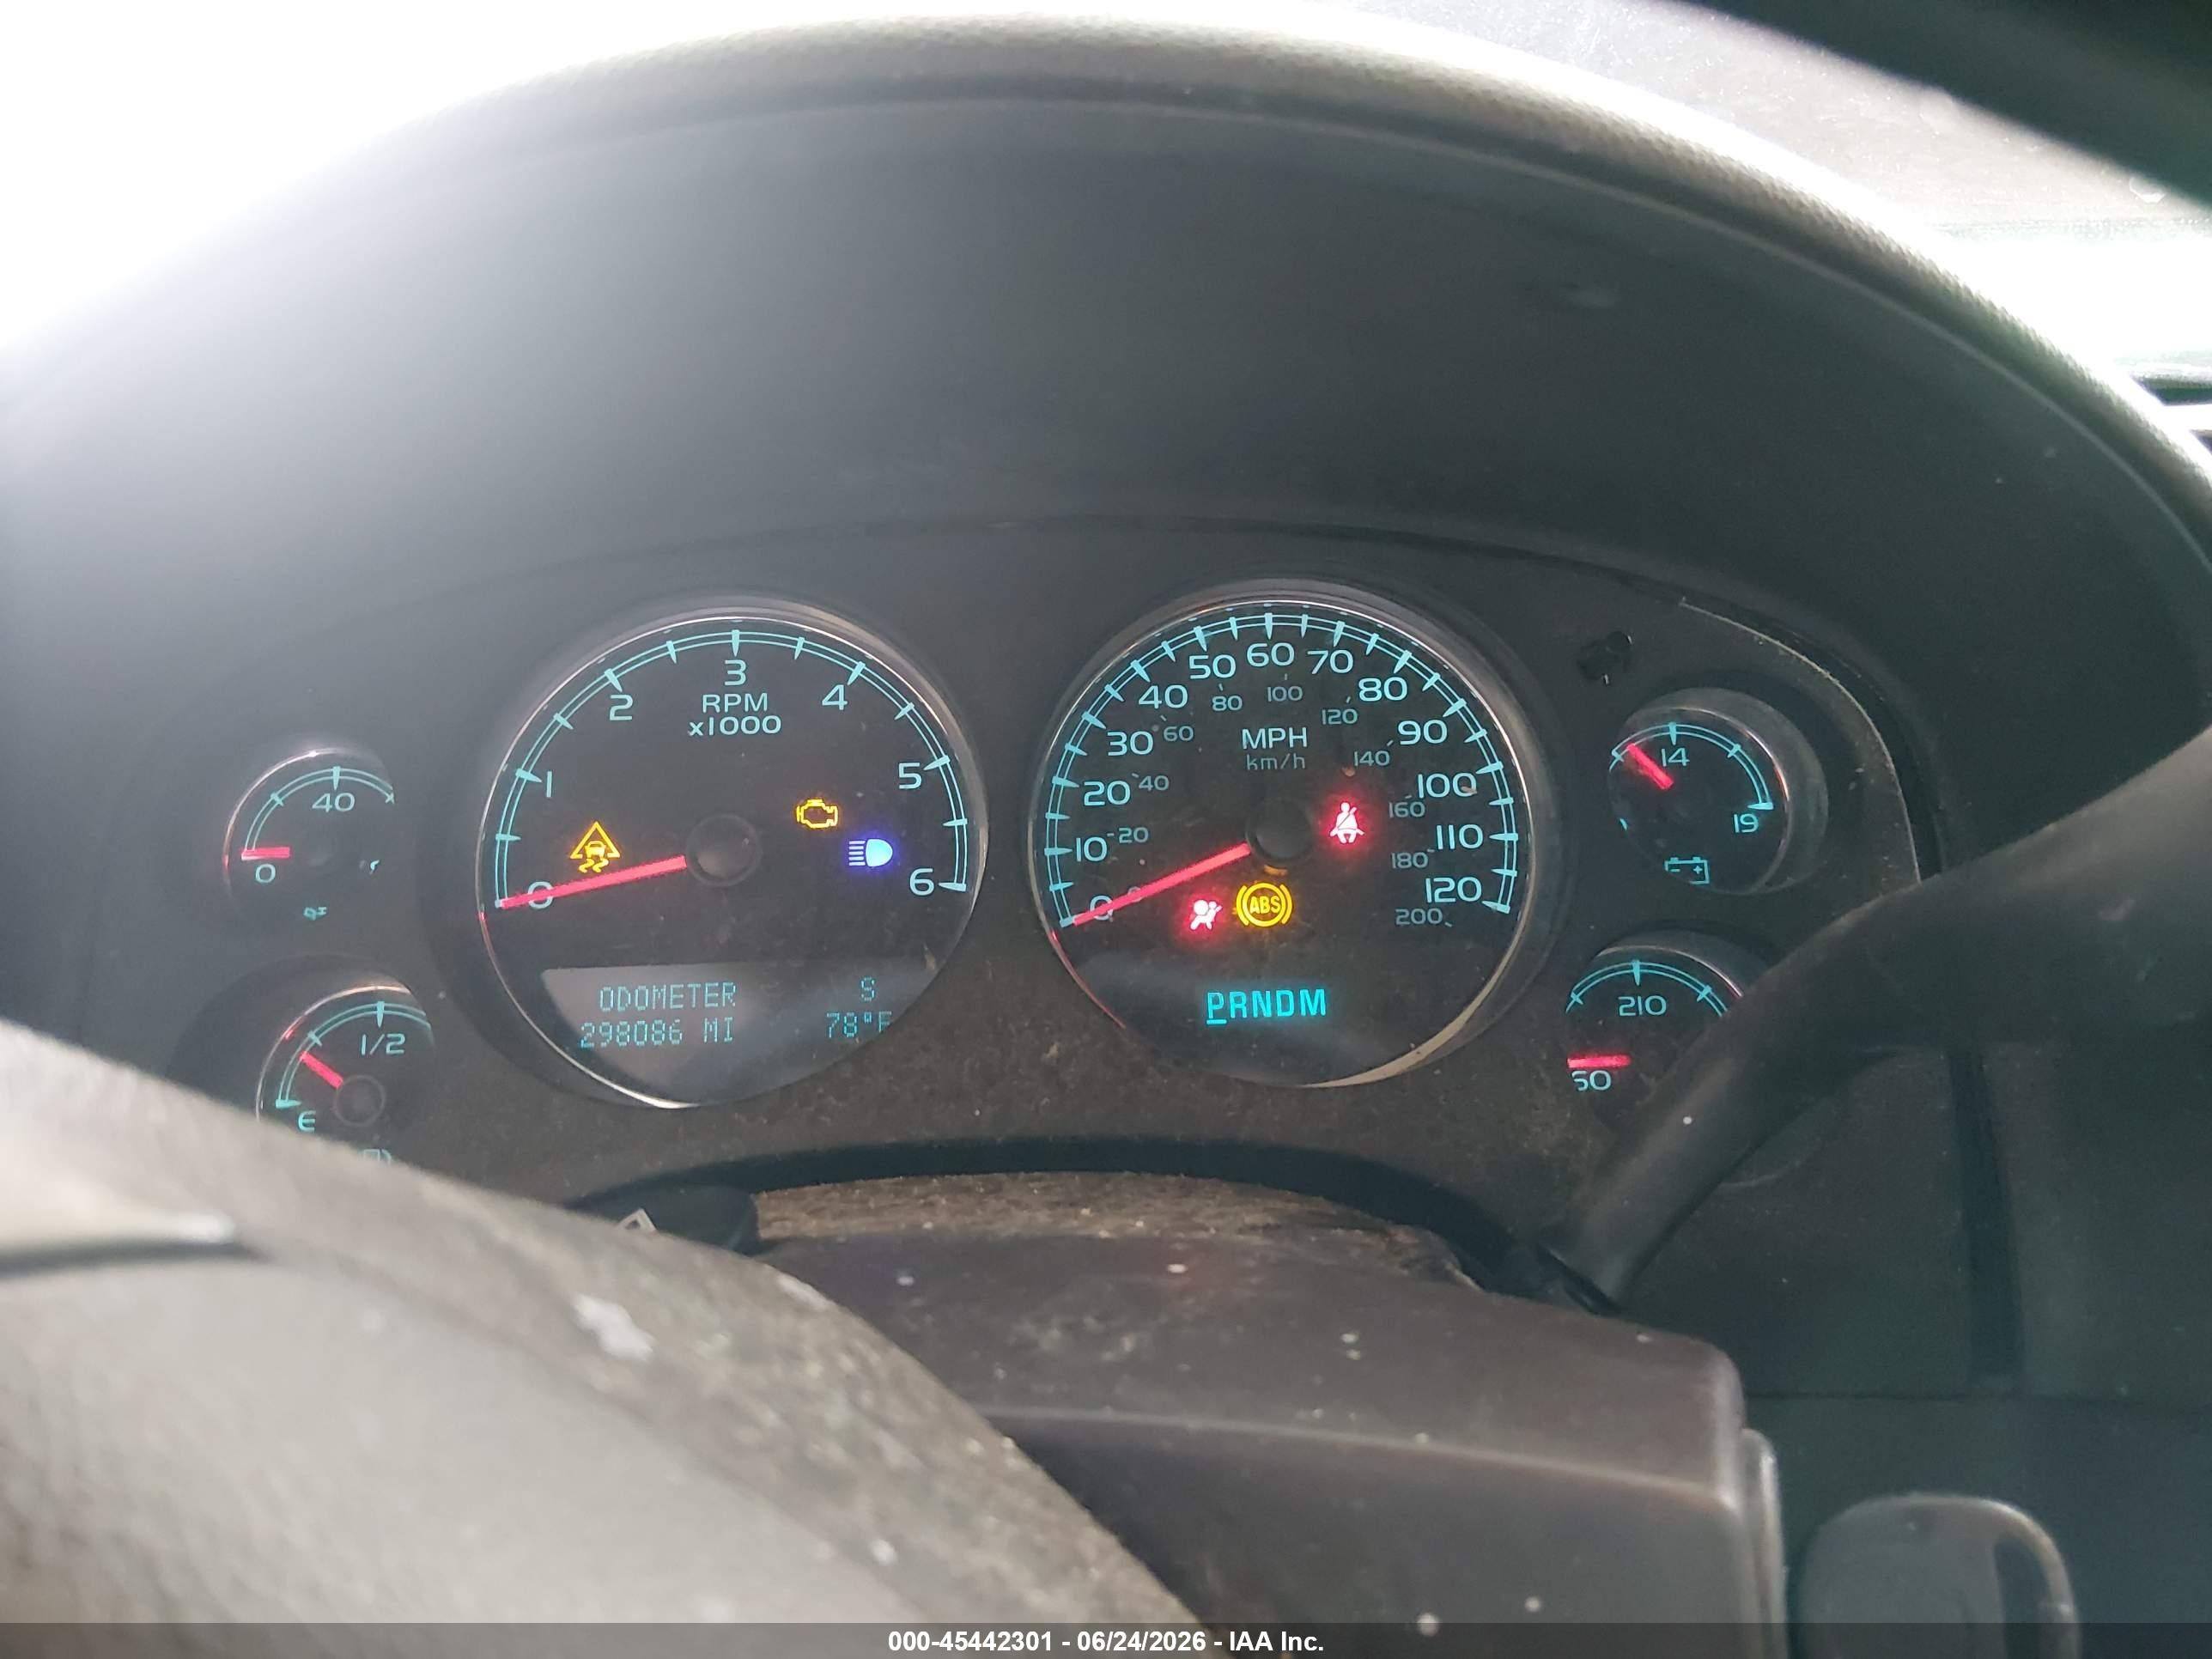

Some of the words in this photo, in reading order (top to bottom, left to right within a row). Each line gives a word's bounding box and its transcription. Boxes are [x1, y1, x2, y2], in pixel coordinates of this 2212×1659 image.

[1188, 654, 1237, 679] 50
[1247, 643, 1294, 667] 60
[1308, 649, 1354, 674] 70
[724, 659, 747, 685] 3
[822, 684, 848, 710] 4
[1138, 684, 1188, 709] 40
[1267, 685, 1303, 702] 100
[1358, 677, 1407, 702] 80
[610, 695, 634, 721] 2
[702, 693, 768, 713] RPM
[1212, 695, 1243, 712] 80
[689, 714, 781, 737] x1000
[1322, 708, 1358, 725] 120
[1107, 731, 1153, 757] 30
[1163, 726, 1194, 742] 60
[1242, 727, 1308, 748] MPH
[1397, 720, 1448, 745] 90
[1247, 752, 1305, 770] km/h
[1354, 750, 1390, 767] 140
[1661, 747, 1690, 767] 14
[545, 770, 552, 798] 1
[898, 762, 922, 789] 5
[1138, 775, 1170, 792] 40
[1418, 773, 1477, 798] 100
[312, 792, 356, 812] 40
[1084, 781, 1131, 806] 20
[1389, 802, 1425, 818] 160
[1733, 812, 1759, 833] 19
[1118, 827, 1149, 844] 20
[1436, 824, 1484, 850] 110
[1076, 836, 1107, 862] 10
[1391, 853, 1429, 869] 180
[256, 864, 276, 884] 0
[909, 868, 935, 896] 6
[528, 881, 554, 908] 0
[1425, 878, 1482, 902] 120
[1249, 896, 1281, 915] ABS
[1395, 908, 1443, 925] 200
[599, 981, 736, 1012] ODOMETER
[860, 977, 875, 1002] S
[1206, 989, 1327, 1022] PRNDM
[1618, 995, 1667, 1017] 210
[361, 1033, 405, 1055] 1/2
[580, 1019, 683, 1048] 298086
[703, 1017, 733, 1042] MI
[297, 1110, 316, 1132] E
